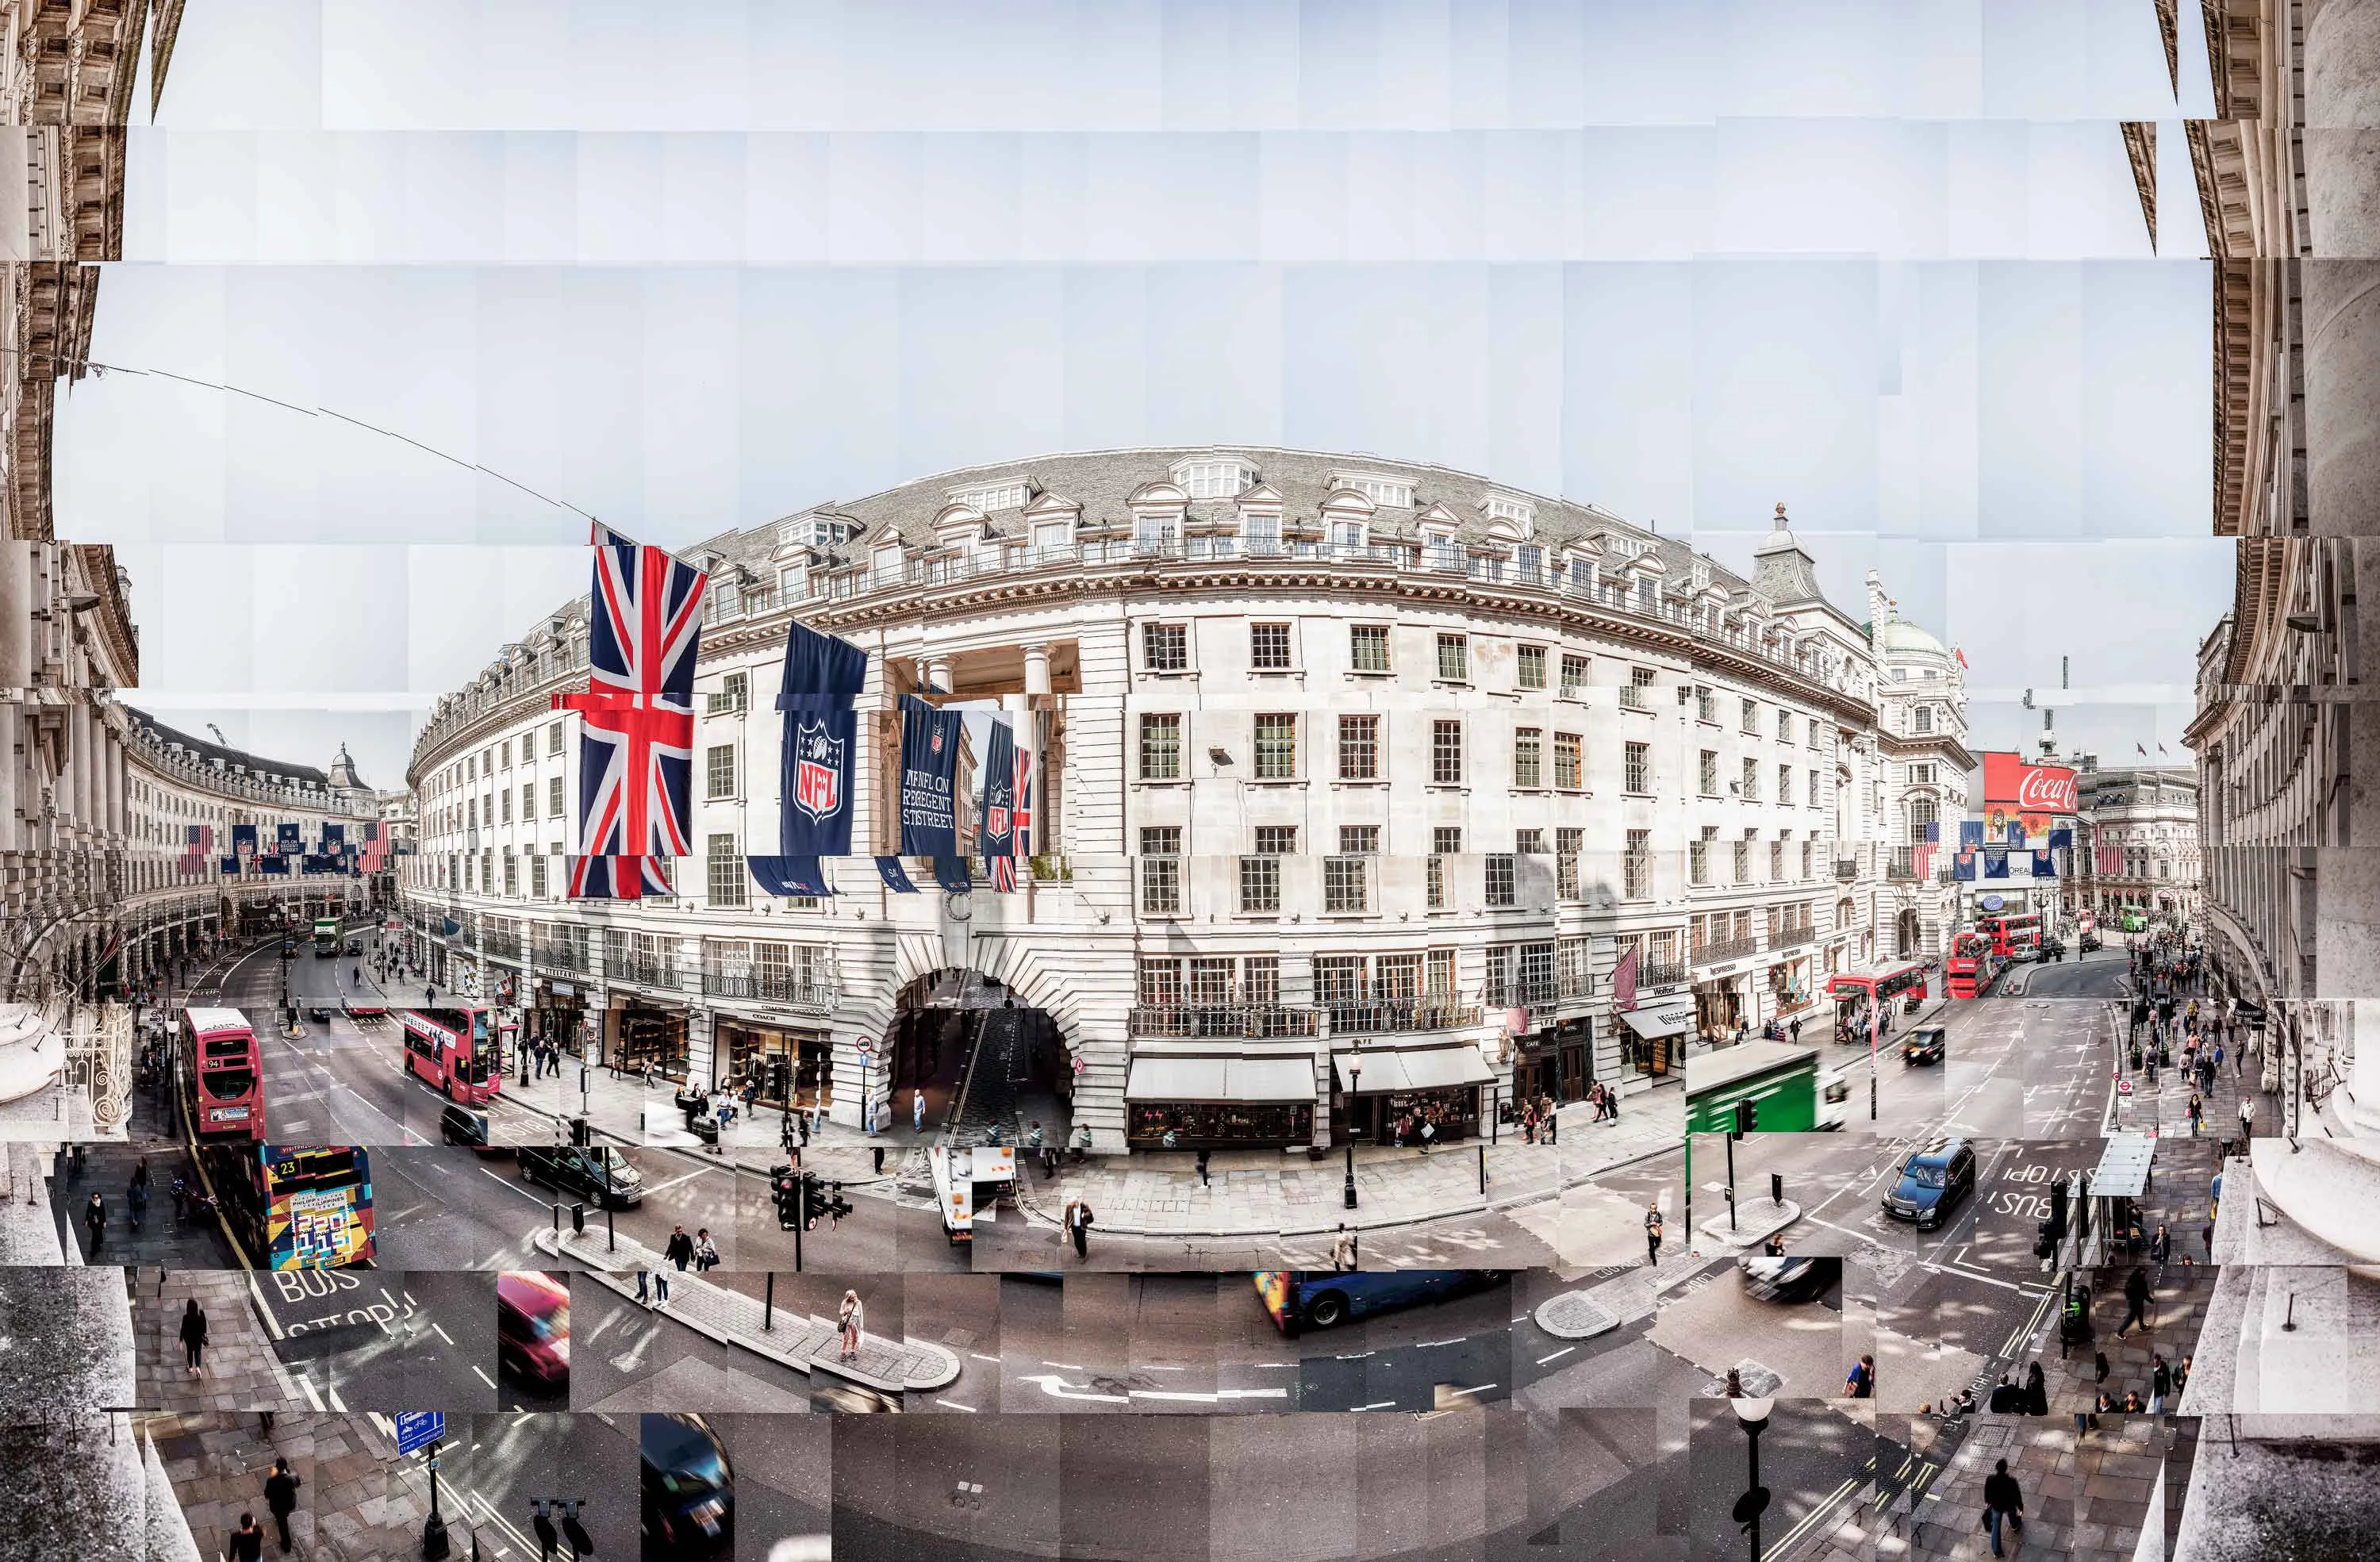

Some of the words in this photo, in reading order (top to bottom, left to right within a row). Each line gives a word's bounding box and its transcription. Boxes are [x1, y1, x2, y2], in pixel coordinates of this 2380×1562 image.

[935, 776, 950, 794] ON
[1710, 963, 1737, 977] NESPRESSO
[1653, 985, 1676, 996] Wolford
[752, 1013, 776, 1022] COACH
[209, 1060, 220, 1069] 94
[280, 1161, 296, 1175] 23
